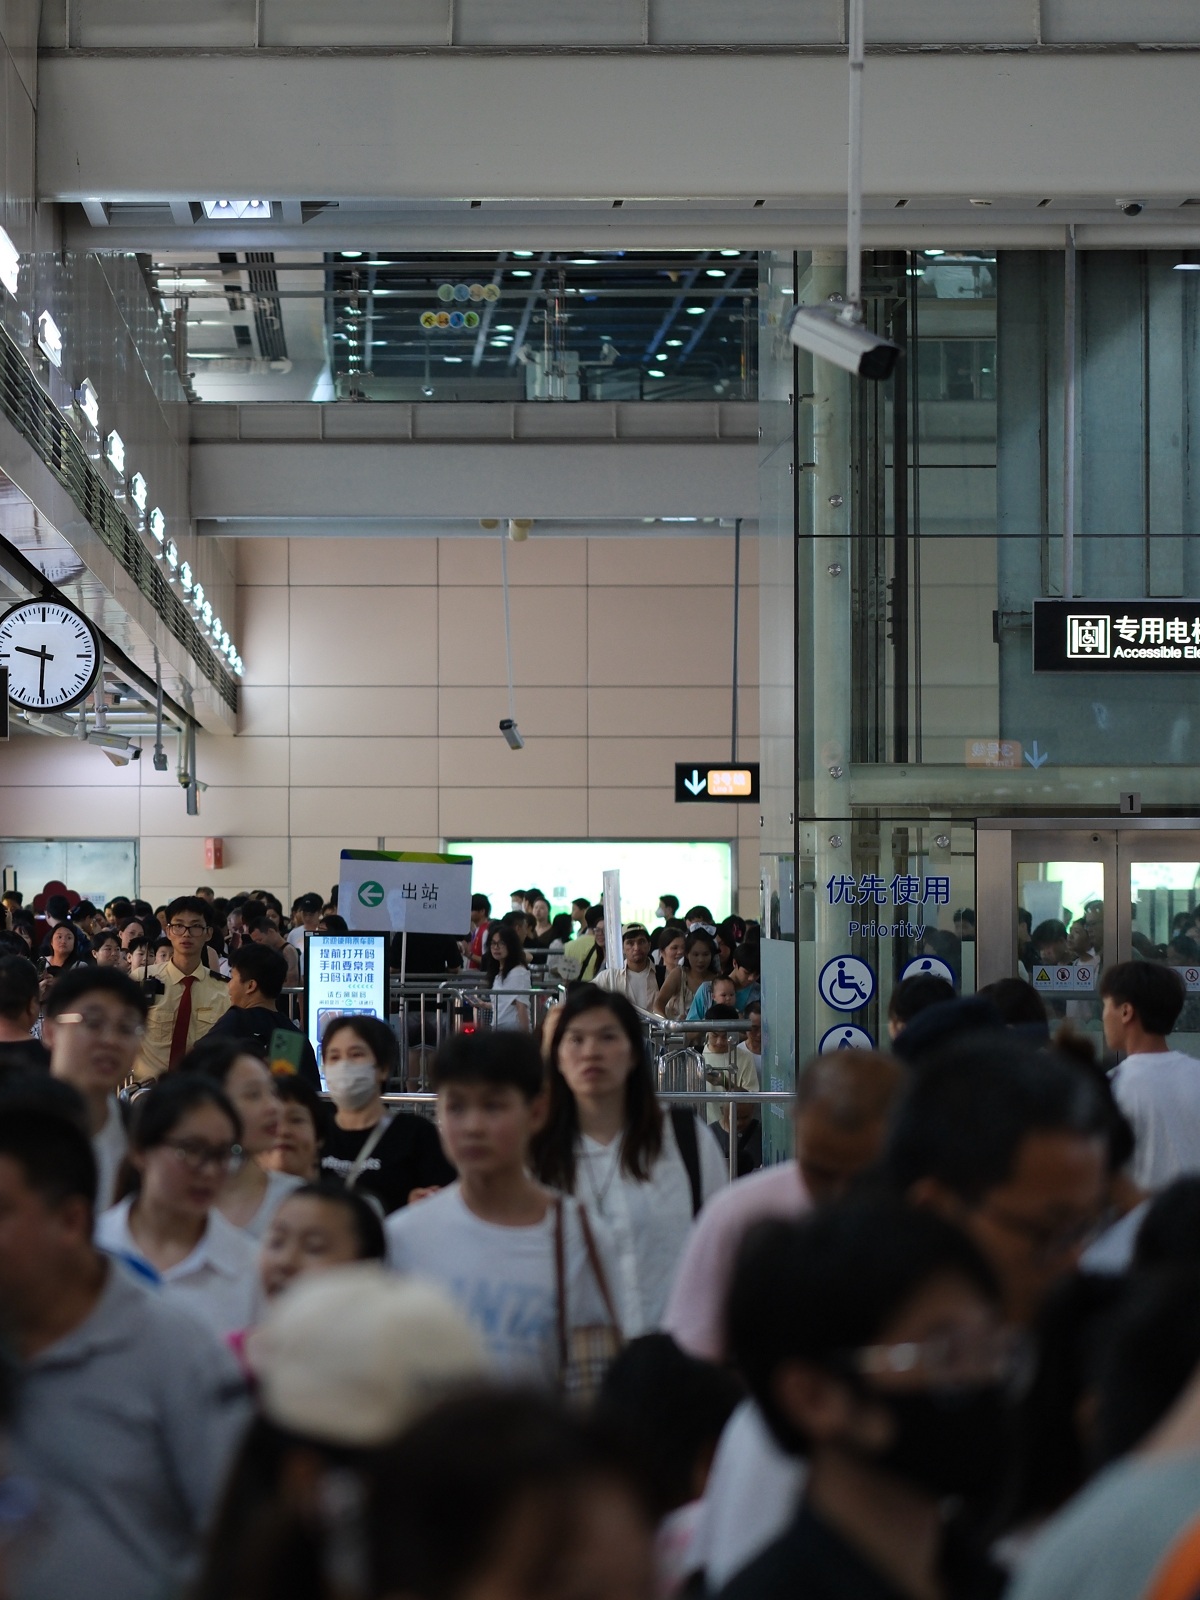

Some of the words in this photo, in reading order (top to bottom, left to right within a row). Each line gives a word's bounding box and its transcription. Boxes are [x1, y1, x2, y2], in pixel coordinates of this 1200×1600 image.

[1113, 645, 1182, 659] Accessible
[1127, 794, 1134, 811] 1
[402, 883, 440, 901] 出站
[826, 874, 951, 906] 优先使用
[422, 902, 437, 910] Exit
[847, 921, 926, 941] Priority
[320, 948, 375, 959] 提前打开码
[320, 960, 375, 971] 手机要常亮
[320, 972, 375, 983] 扫码请对准
